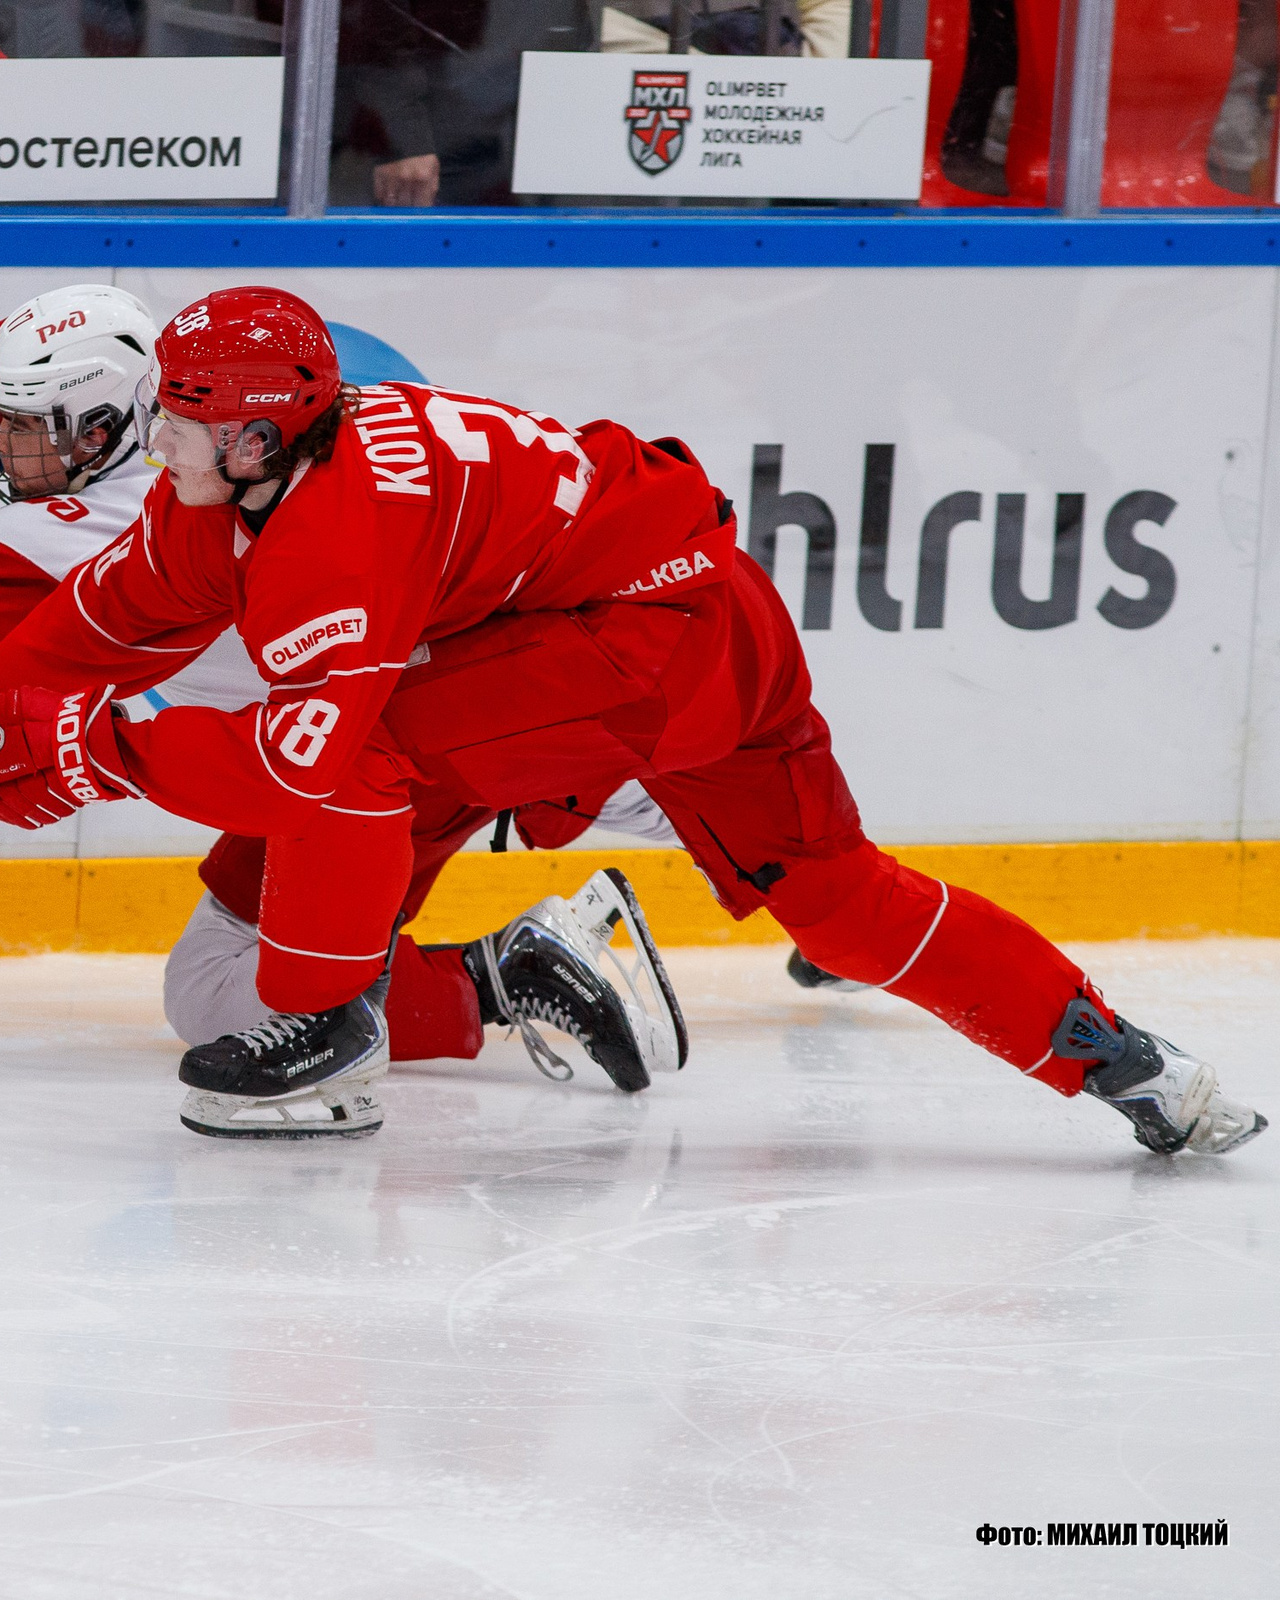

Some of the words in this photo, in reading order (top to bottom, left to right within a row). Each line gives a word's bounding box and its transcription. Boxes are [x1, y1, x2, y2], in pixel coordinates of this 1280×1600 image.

[633, 87, 686, 108] МХЛ
[705, 80, 788, 98] OLIMPBET
[703, 104, 825, 123] МОЛОДЕЖНАЯ
[701, 124, 803, 145] ХОККЕЙНАЯ
[699, 151, 743, 168] ЛИГА
[174, 305, 210, 337] 38
[245, 393, 292, 403] CCM
[745, 443, 1179, 632] hlrus
[271, 618, 363, 666] OLIMPBET
[56, 692, 108, 804] МОСКВ
[551, 963, 597, 1004] BAUER
[286, 1047, 335, 1079] BAUER
